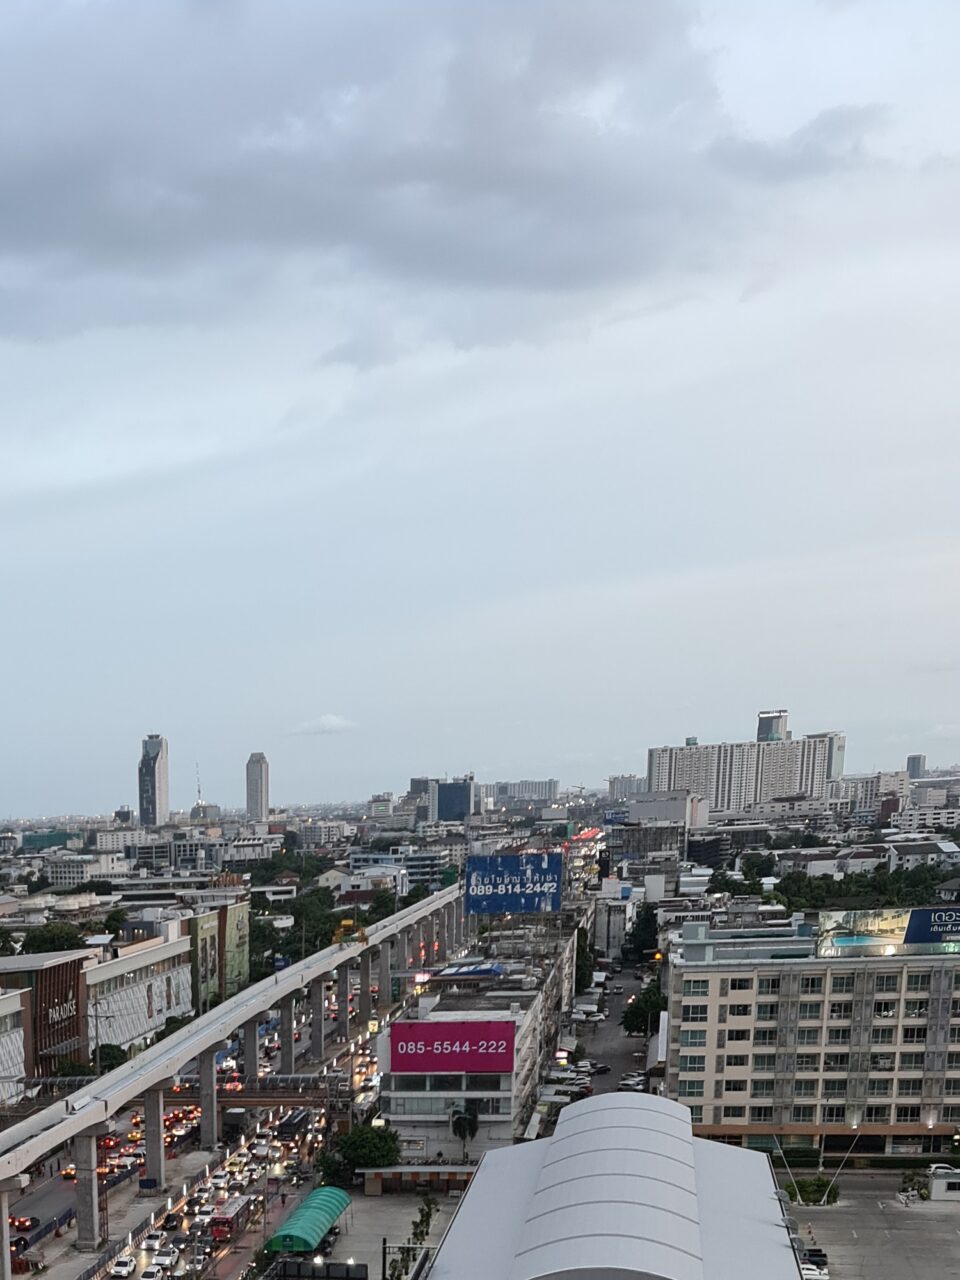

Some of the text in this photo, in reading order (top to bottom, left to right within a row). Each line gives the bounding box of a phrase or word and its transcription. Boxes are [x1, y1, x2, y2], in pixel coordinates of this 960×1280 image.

[469, 882, 557, 895] 089-814-2442
[49, 1000, 76, 1024] PARADISE
[398, 1040, 507, 1054] 085-5544-222
